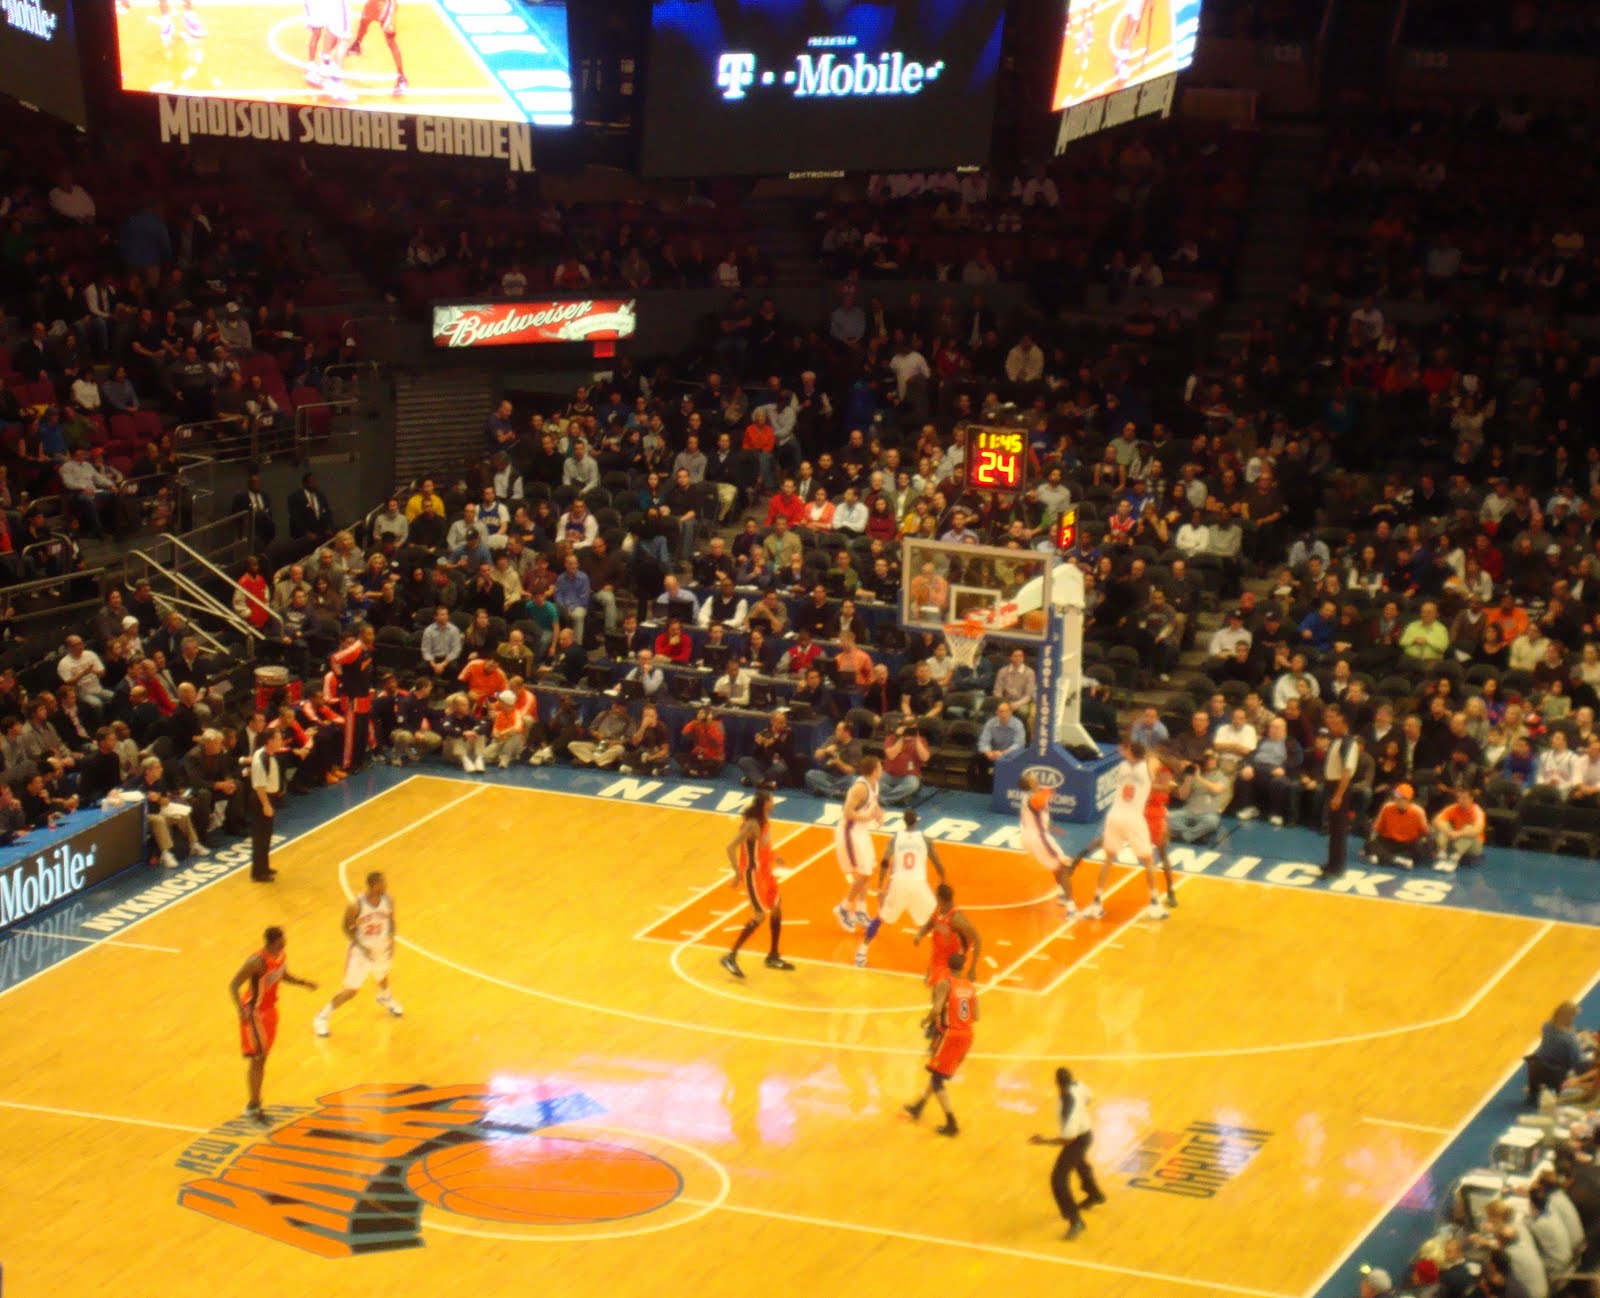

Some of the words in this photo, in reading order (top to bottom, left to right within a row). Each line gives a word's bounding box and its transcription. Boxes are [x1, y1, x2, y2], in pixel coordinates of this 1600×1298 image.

[159, 95, 290, 144] MADISON
[298, 106, 407, 151] SQUARE
[416, 115, 533, 172] GARDEN
[443, 300, 592, 347] Budweiser
[978, 433, 1022, 452] 11:45
[978, 452, 1014, 483] 24
[903, 852, 915, 870] 0
